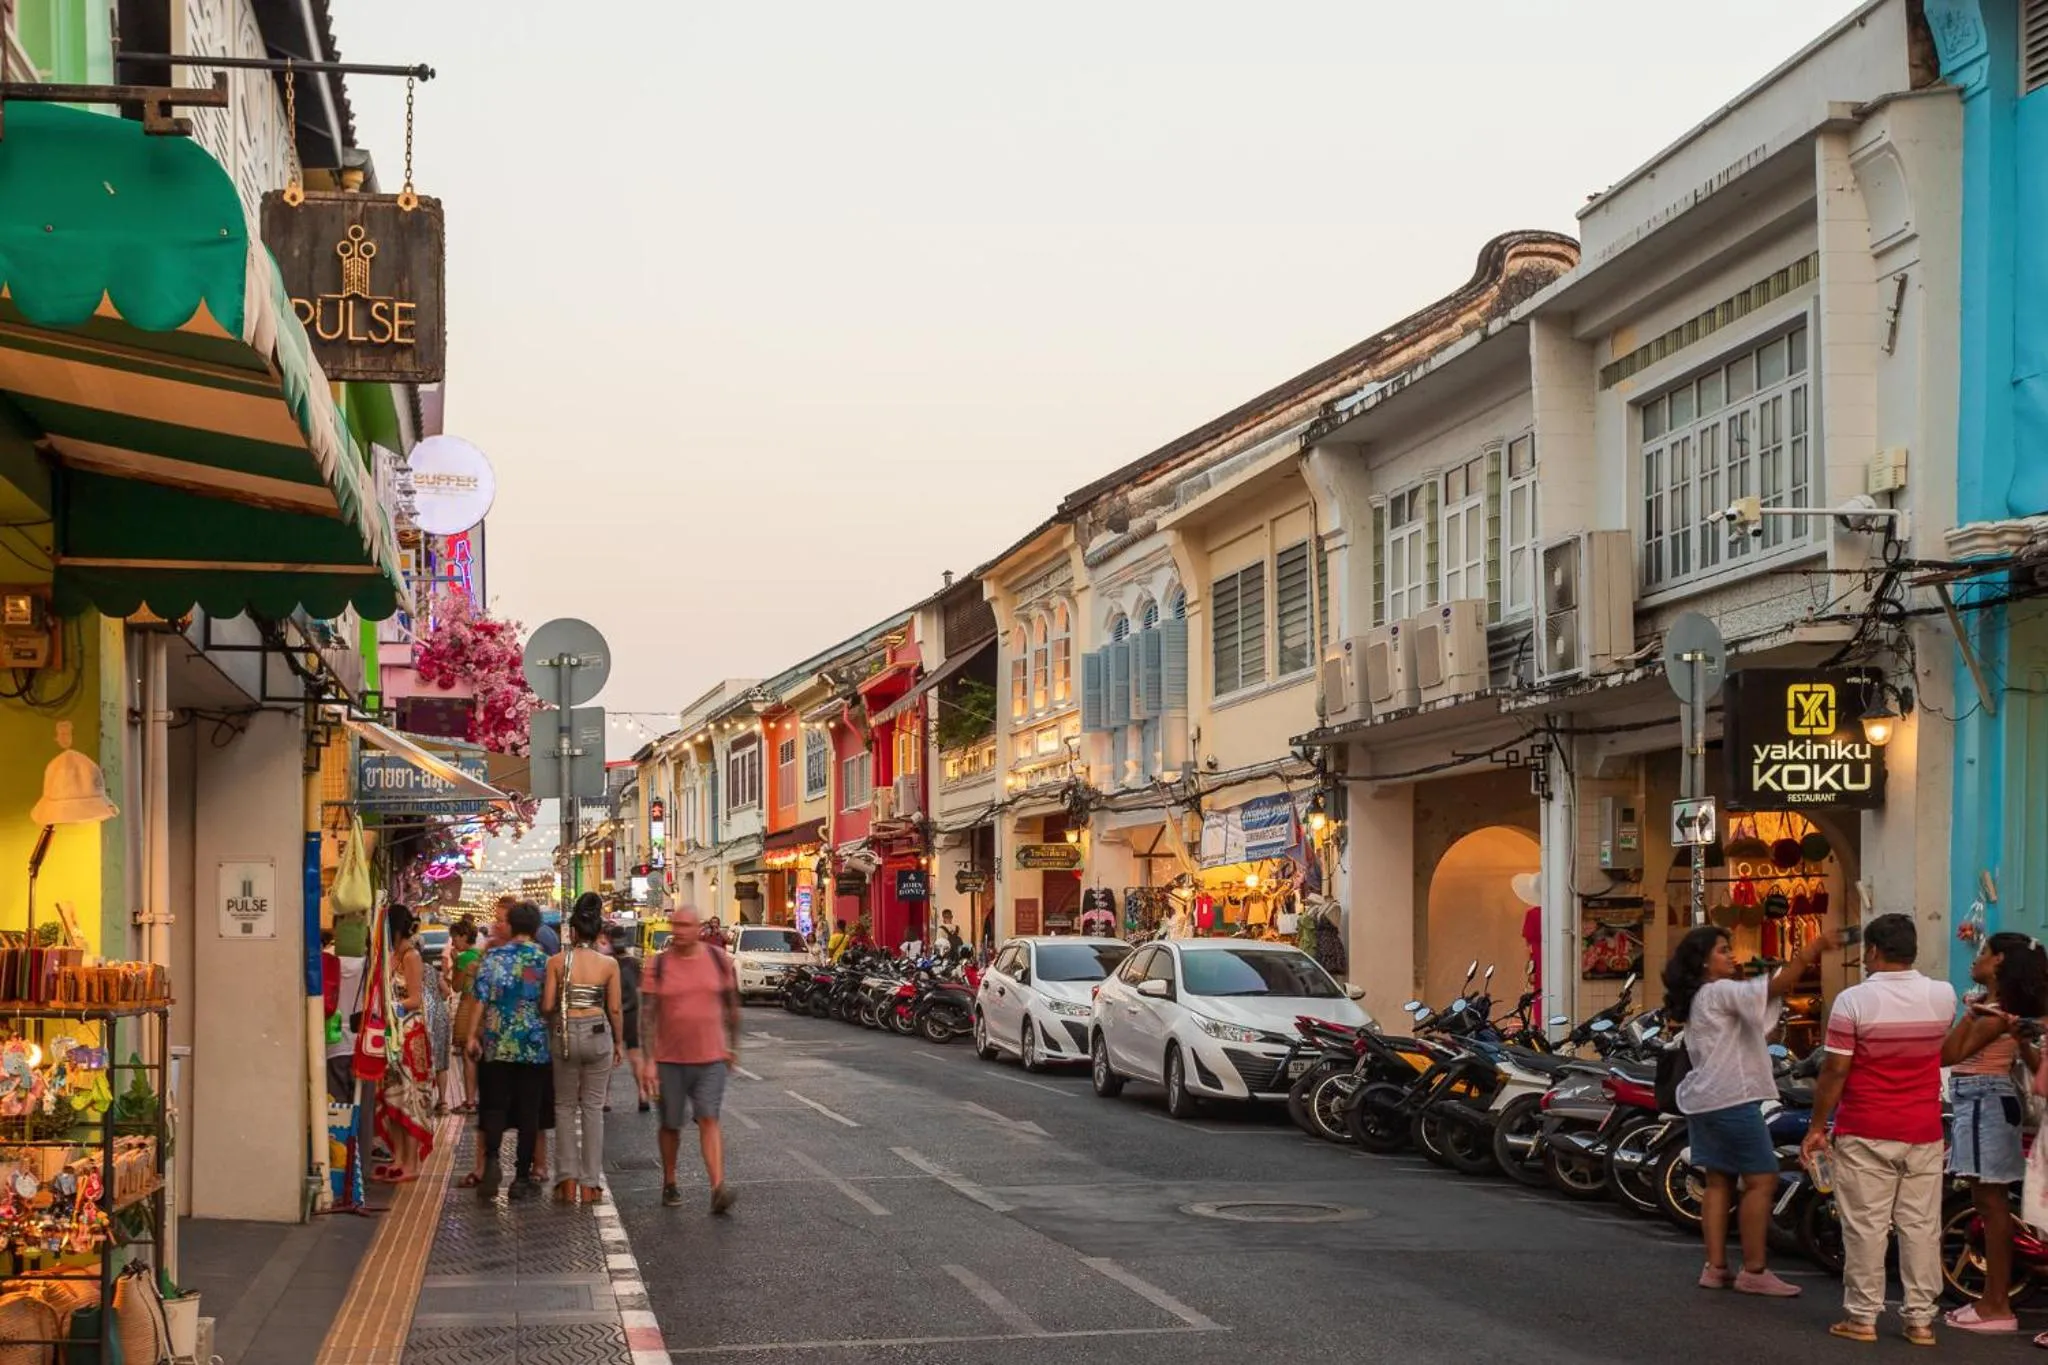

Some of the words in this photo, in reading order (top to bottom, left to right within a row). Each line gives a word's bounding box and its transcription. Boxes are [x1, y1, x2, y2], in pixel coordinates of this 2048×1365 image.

[291, 298, 416, 343] PULSE
[1753, 739, 1871, 763] yakiniku
[1752, 764, 1871, 791] KOKU
[1787, 793, 1836, 802] RESTAURANT
[227, 899, 268, 912] PULSE
